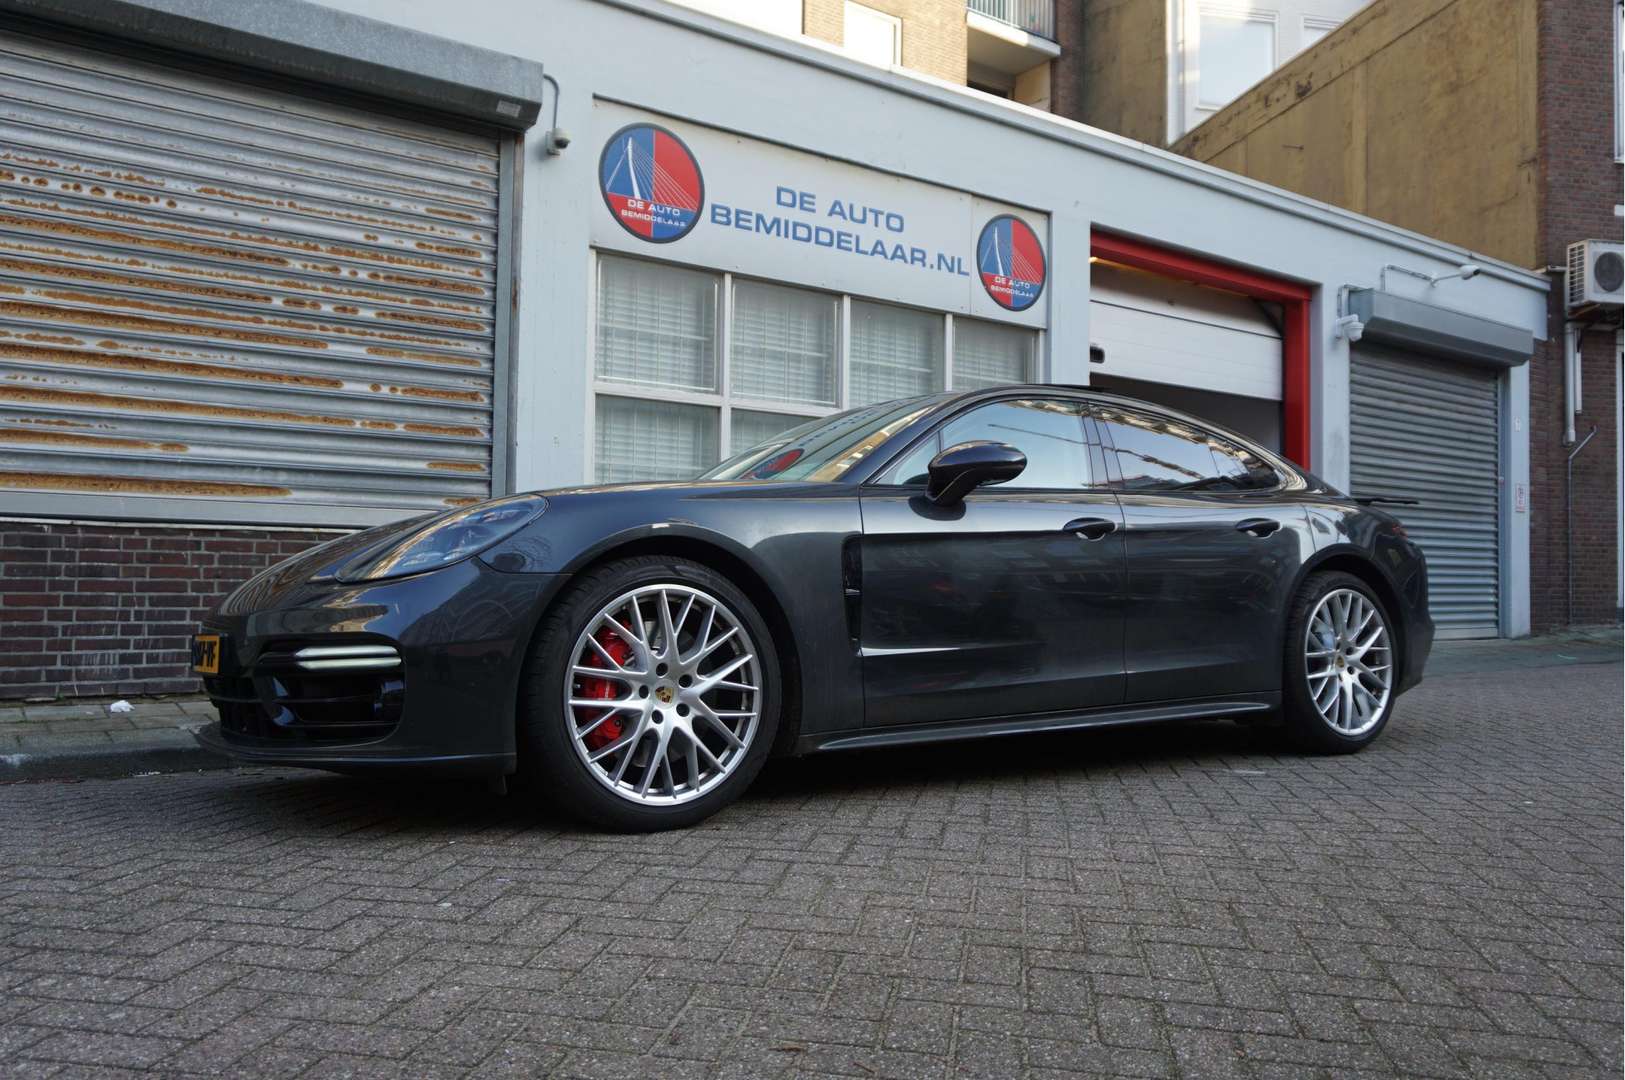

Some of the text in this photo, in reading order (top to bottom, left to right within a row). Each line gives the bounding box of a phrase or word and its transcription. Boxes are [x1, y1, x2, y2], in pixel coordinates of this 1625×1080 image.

[627, 199, 681, 216] DE AUTO
[776, 186, 904, 233] DE AUTO
[710, 203, 970, 277] BEMIDDELAAR.NL
[994, 276, 1031, 289] DE AUTO
